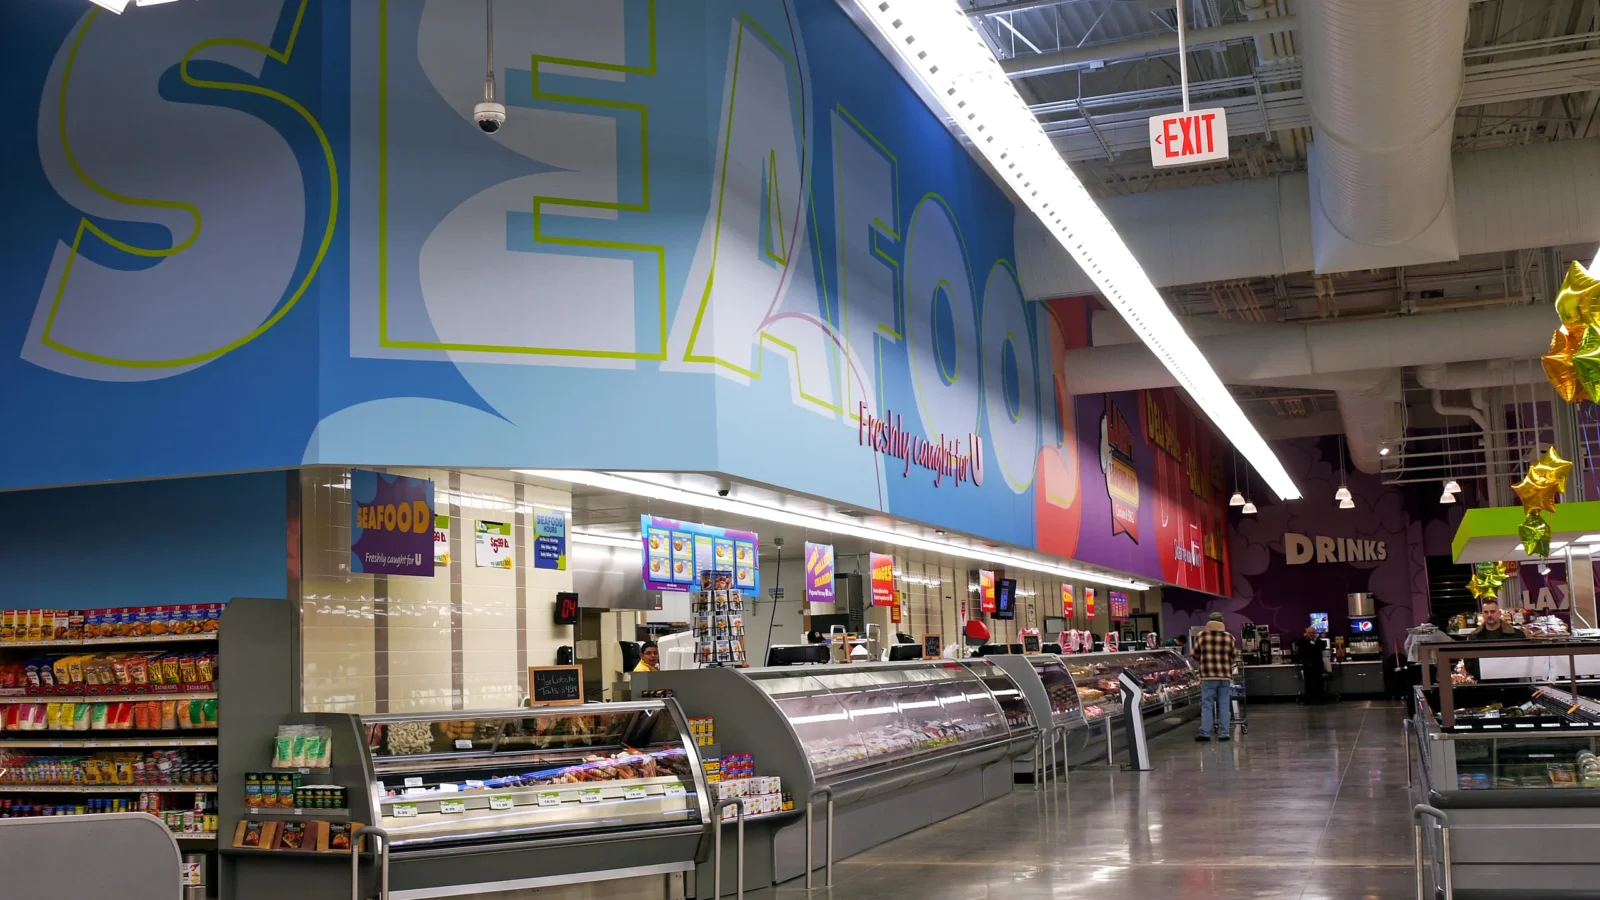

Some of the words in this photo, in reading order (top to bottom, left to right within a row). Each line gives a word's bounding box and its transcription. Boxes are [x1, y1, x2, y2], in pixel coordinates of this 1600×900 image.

[1163, 113, 1216, 158] EXIT
[20, 0, 1079, 509] SEAFOOD
[858, 400, 911, 478] Freshly
[912, 433, 953, 488] caught
[954, 438, 969, 487] for
[968, 433, 984, 487] U
[356, 500, 430, 534] SEAFOOD
[536, 515, 563, 527] SEAFOOD
[365, 552, 387, 567] Freshly
[387, 554, 407, 568] caught
[406, 554, 414, 566] for
[414, 553, 422, 566] U
[1284, 532, 1387, 566] DRINKS
[561, 598, 576, 619] 04
